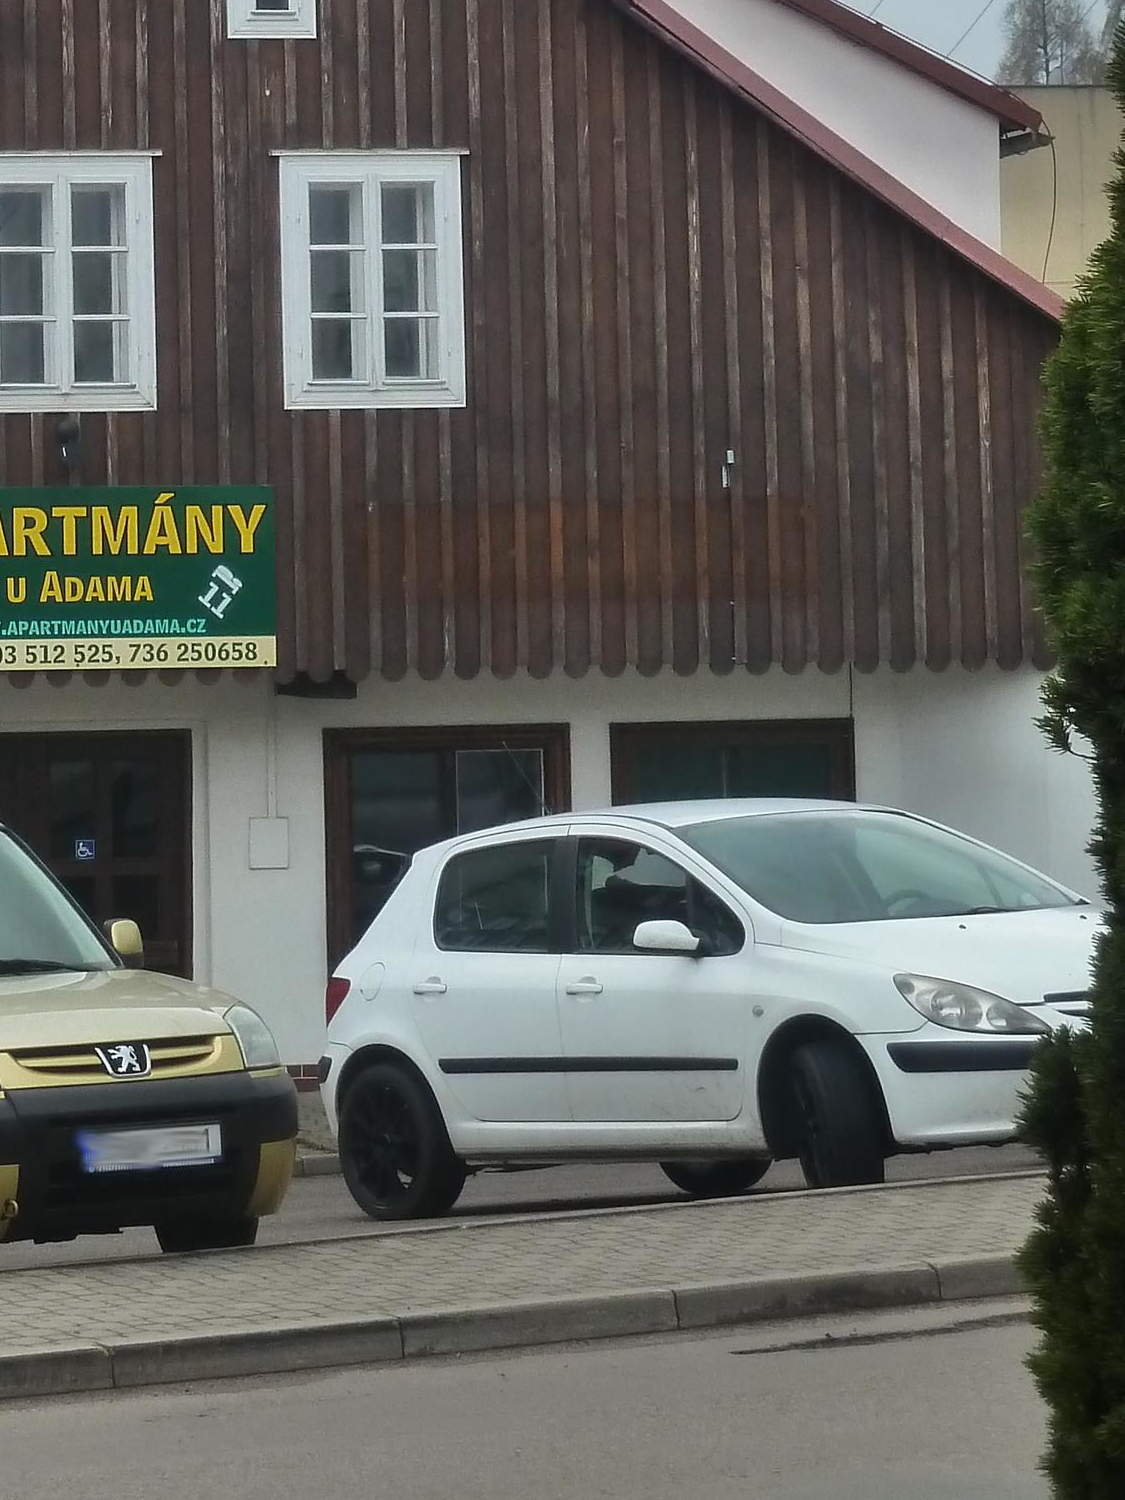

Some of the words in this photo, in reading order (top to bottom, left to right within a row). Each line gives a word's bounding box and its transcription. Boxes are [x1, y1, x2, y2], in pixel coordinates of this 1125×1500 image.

[25, 645, 66, 665] 512
[73, 644, 121, 664] 525,
[128, 643, 169, 663] 736
[176, 642, 258, 662] 250658
